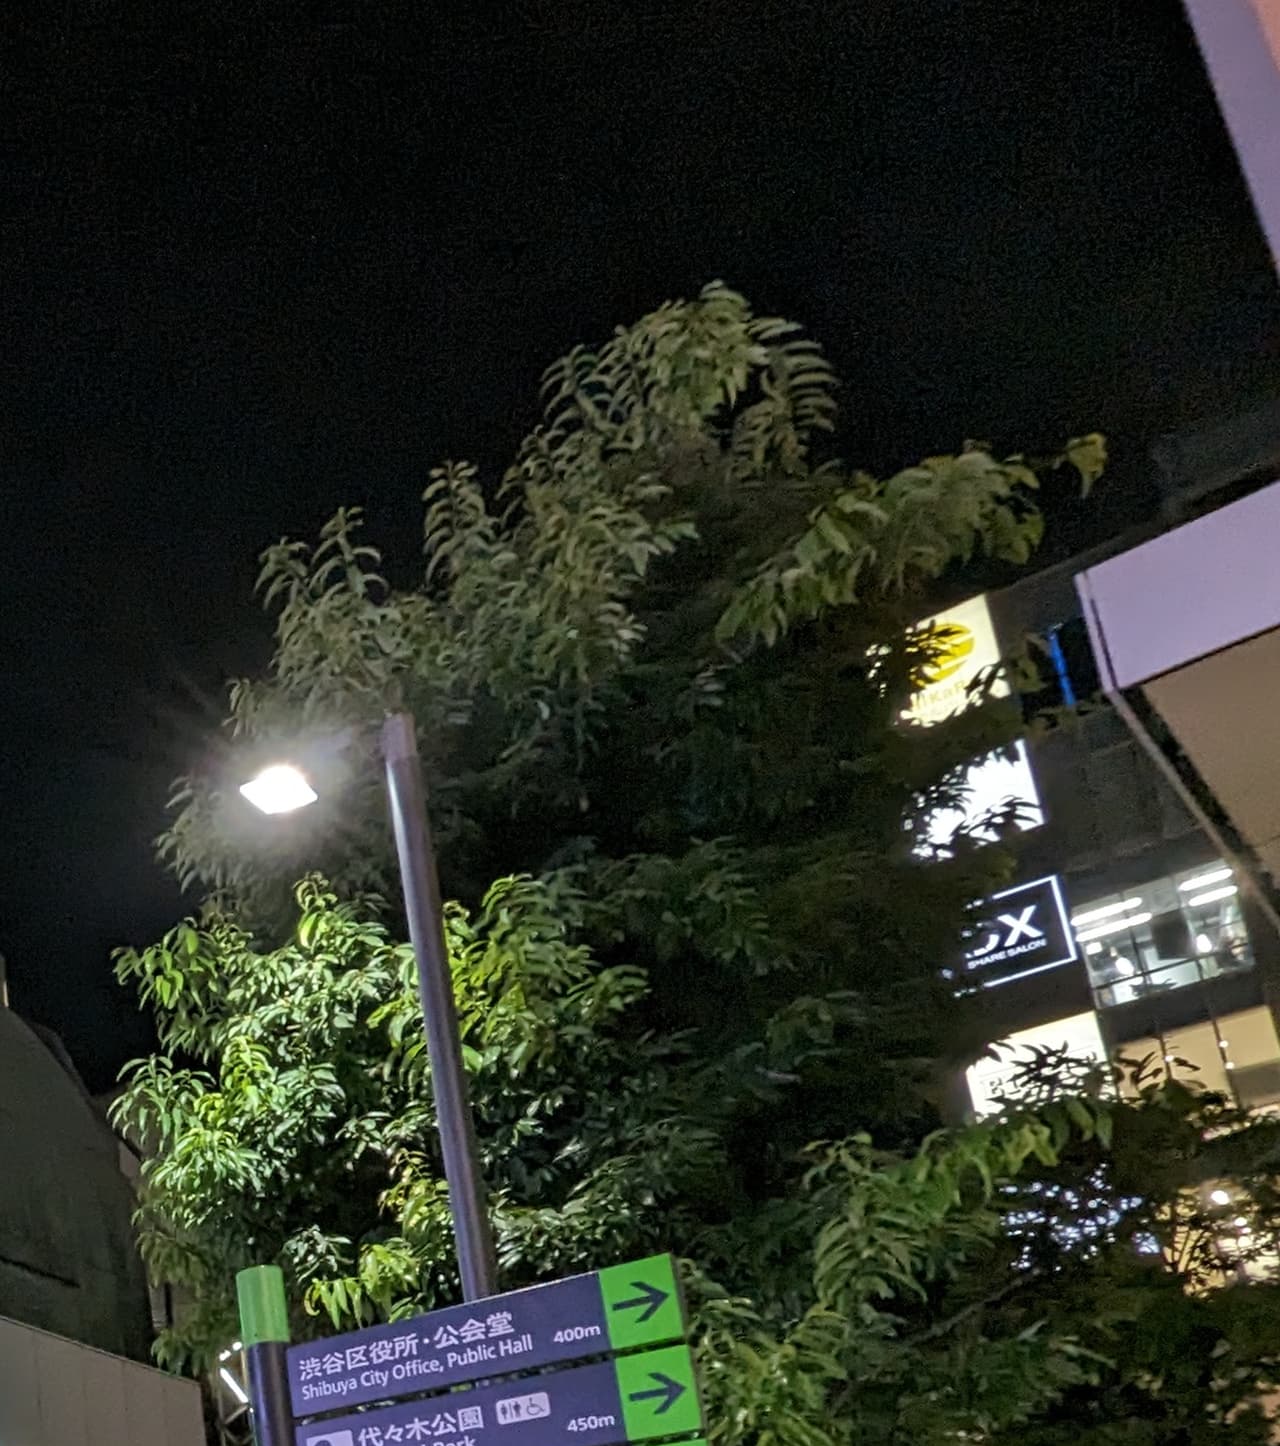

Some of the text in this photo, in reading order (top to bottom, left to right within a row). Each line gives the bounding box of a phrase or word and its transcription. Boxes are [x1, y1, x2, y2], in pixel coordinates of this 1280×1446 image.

[1007, 938, 1047, 957] SALON
[553, 1324, 602, 1344] 400m
[299, 1311, 516, 1381] 渋谷区役所・公会堂
[301, 1334, 533, 1400] Shibuya City Office, Public Hall
[567, 1414, 616, 1433] 450m
